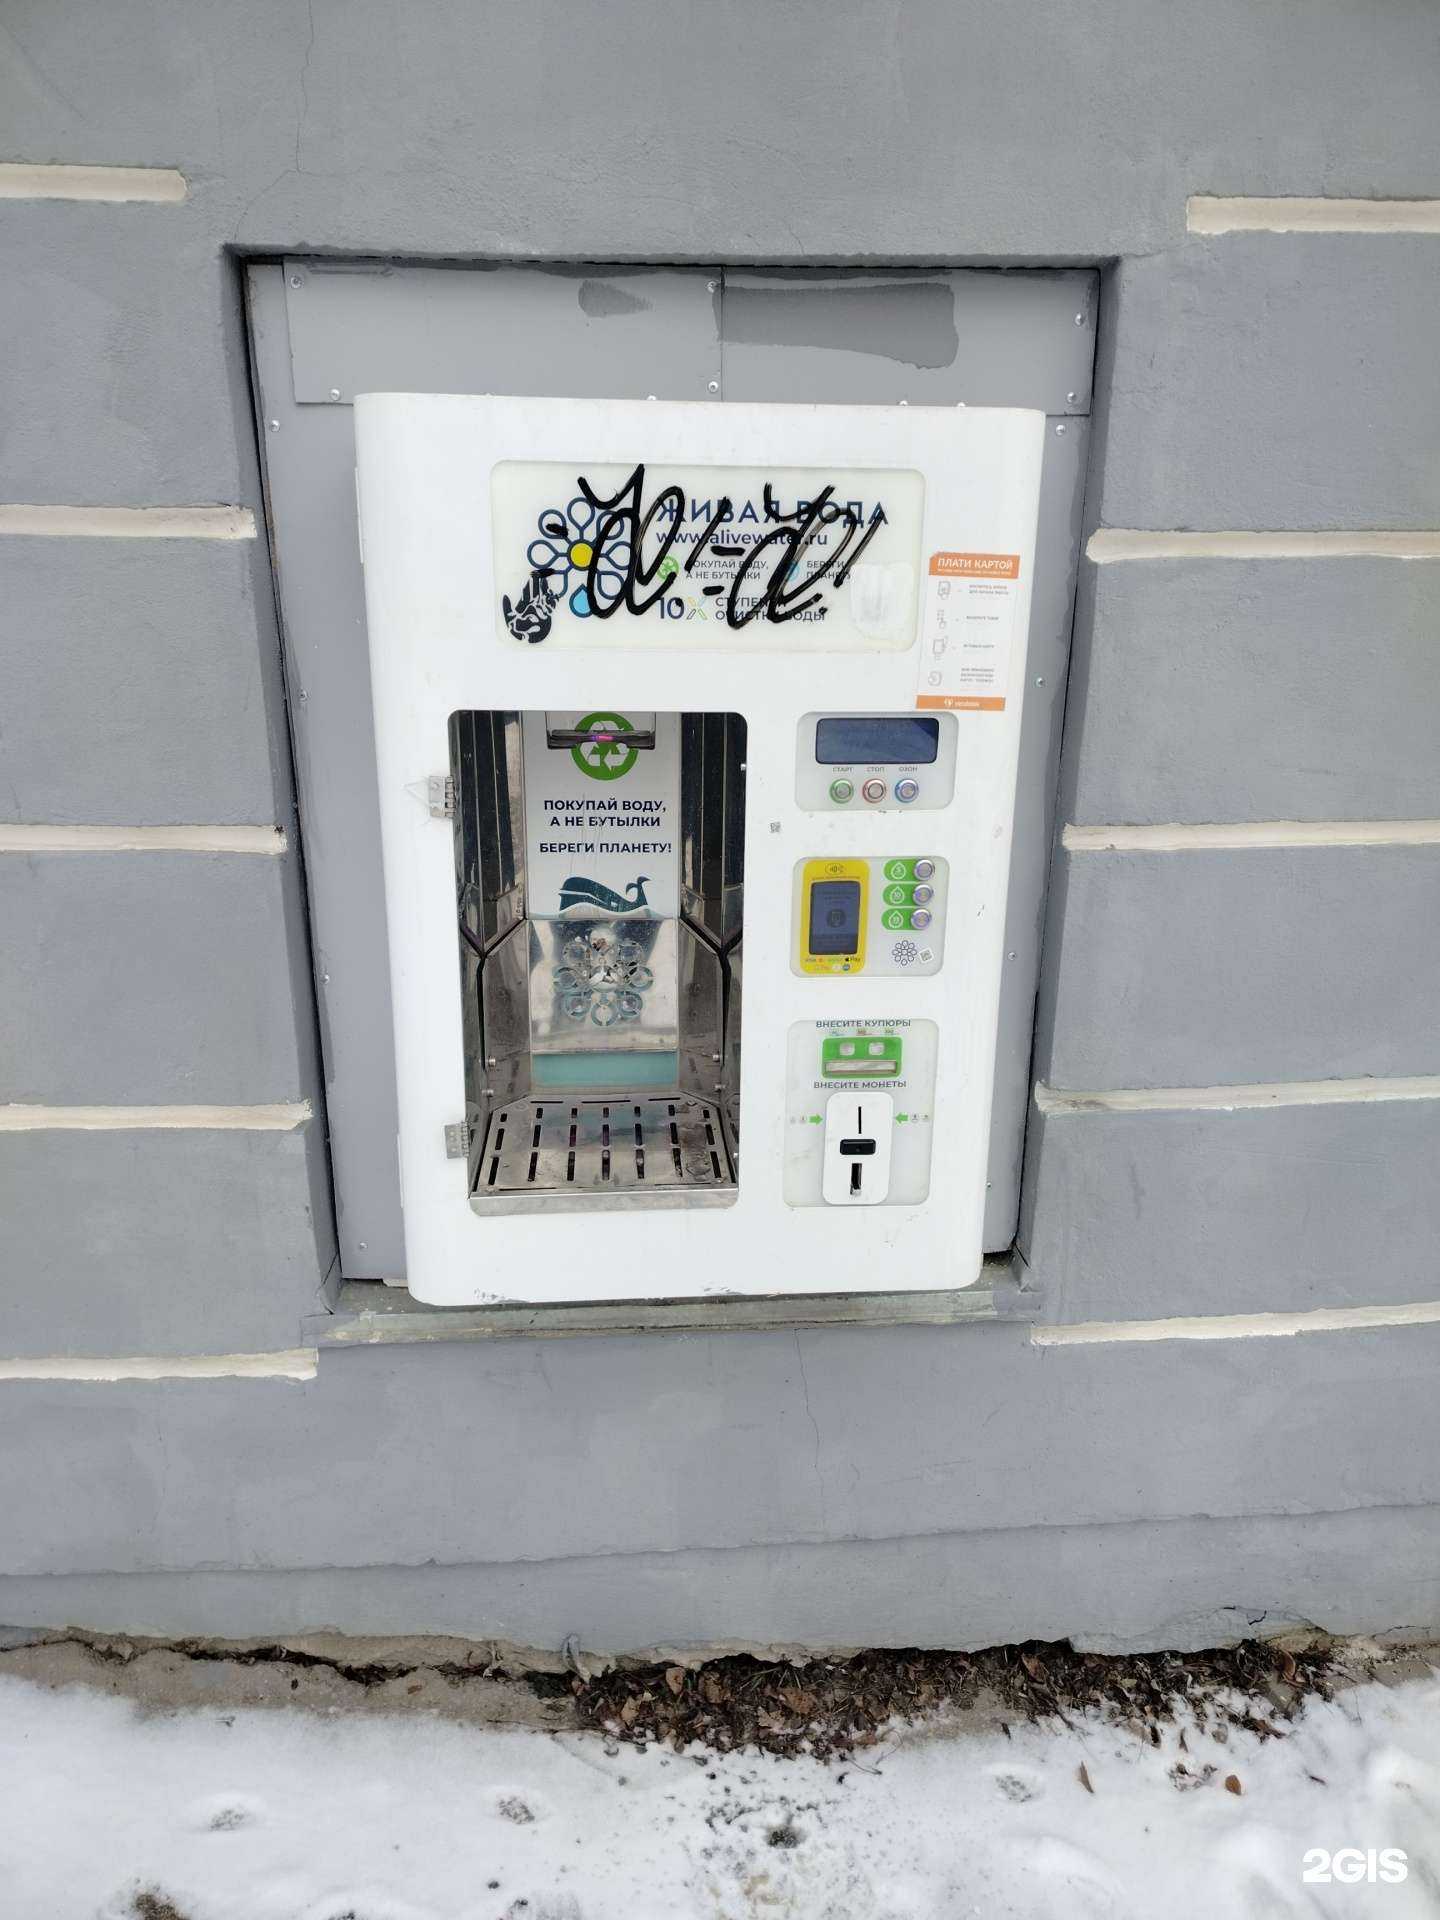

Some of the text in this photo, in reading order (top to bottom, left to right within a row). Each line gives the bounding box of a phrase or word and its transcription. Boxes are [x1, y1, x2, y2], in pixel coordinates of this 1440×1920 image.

[937, 558, 1013, 569] ПЛАТИ КАРТОЙ
[696, 571, 709, 580] НЕ
[544, 798, 667, 813] ПОКУПАЙ ВОДУ,
[550, 816, 661, 827] А НЕ БУТЫЛКИ
[539, 842, 672, 853] БЕРЕГИ ПЛАНЕТУ!
[816, 1019, 911, 1028] ВНЕСИТЕ КУПЮРЫ
[813, 1080, 907, 1089] ВНЕСИТЕ МОНЕТЫ
